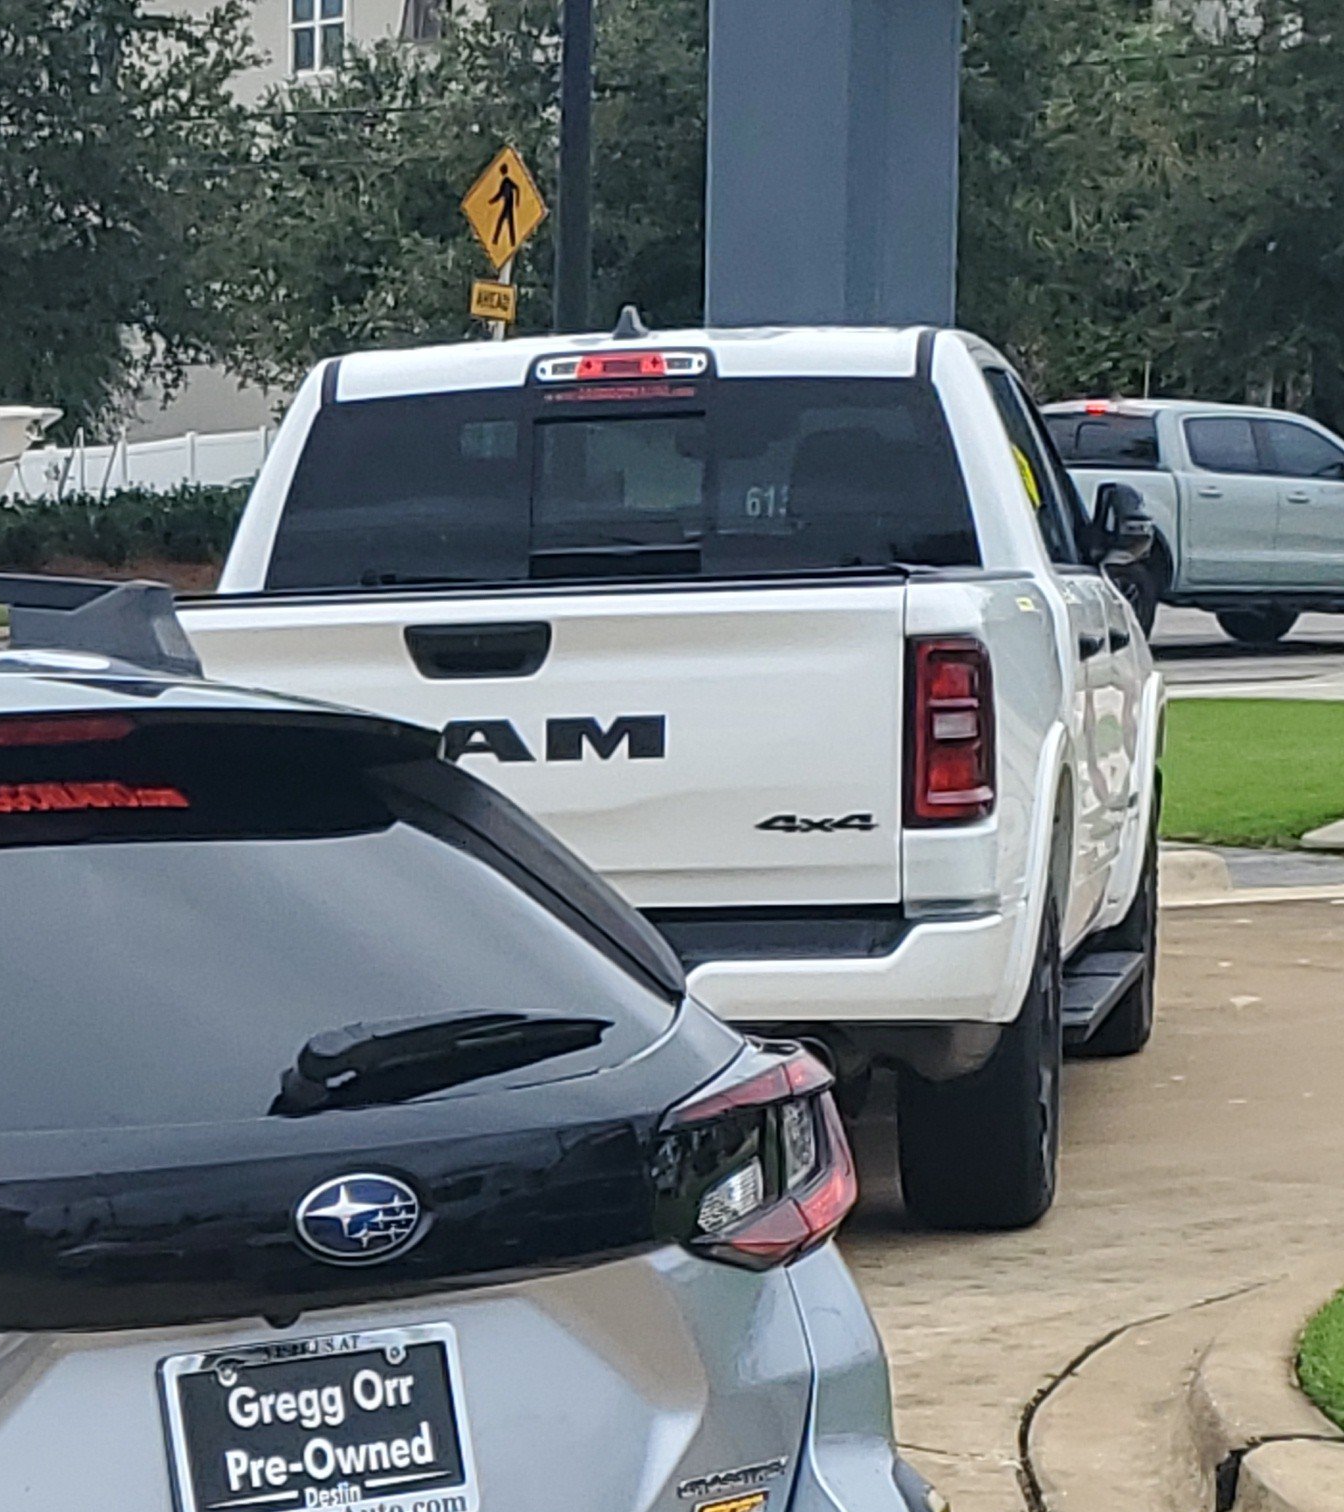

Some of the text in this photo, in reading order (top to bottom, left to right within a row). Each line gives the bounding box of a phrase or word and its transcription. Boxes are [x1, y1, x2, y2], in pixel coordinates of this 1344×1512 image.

[476, 291, 511, 312] AHEAD
[442, 714, 666, 763] AM
[755, 812, 879, 834] 4x4
[228, 1369, 413, 1430] Gregg Orr
[224, 1421, 435, 1492] Pre-Owned
